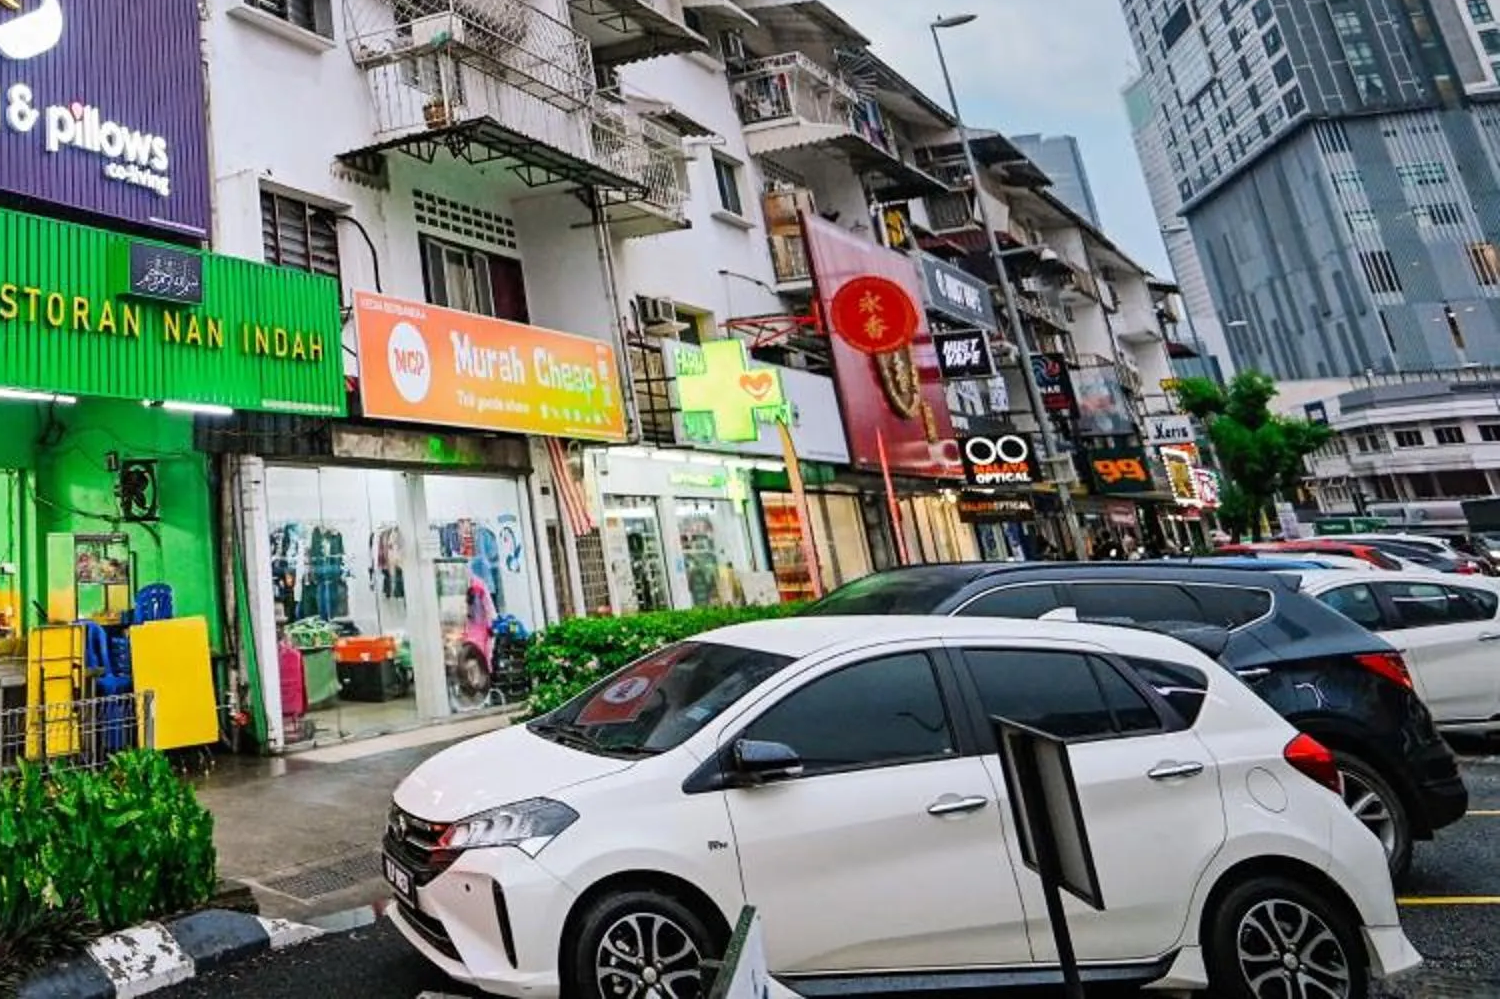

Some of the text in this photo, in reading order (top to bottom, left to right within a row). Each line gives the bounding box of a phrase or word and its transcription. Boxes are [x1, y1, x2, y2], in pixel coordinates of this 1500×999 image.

[7, 82, 40, 133] &
[46, 101, 169, 173] pillows
[163, 311, 224, 349] NAN
[242, 323, 325, 363] INDAH
[945, 350, 981, 369] VAPE
[450, 330, 526, 386] Murah
[533, 345, 597, 405] Cheap
[975, 471, 1032, 485] OPTICAL
